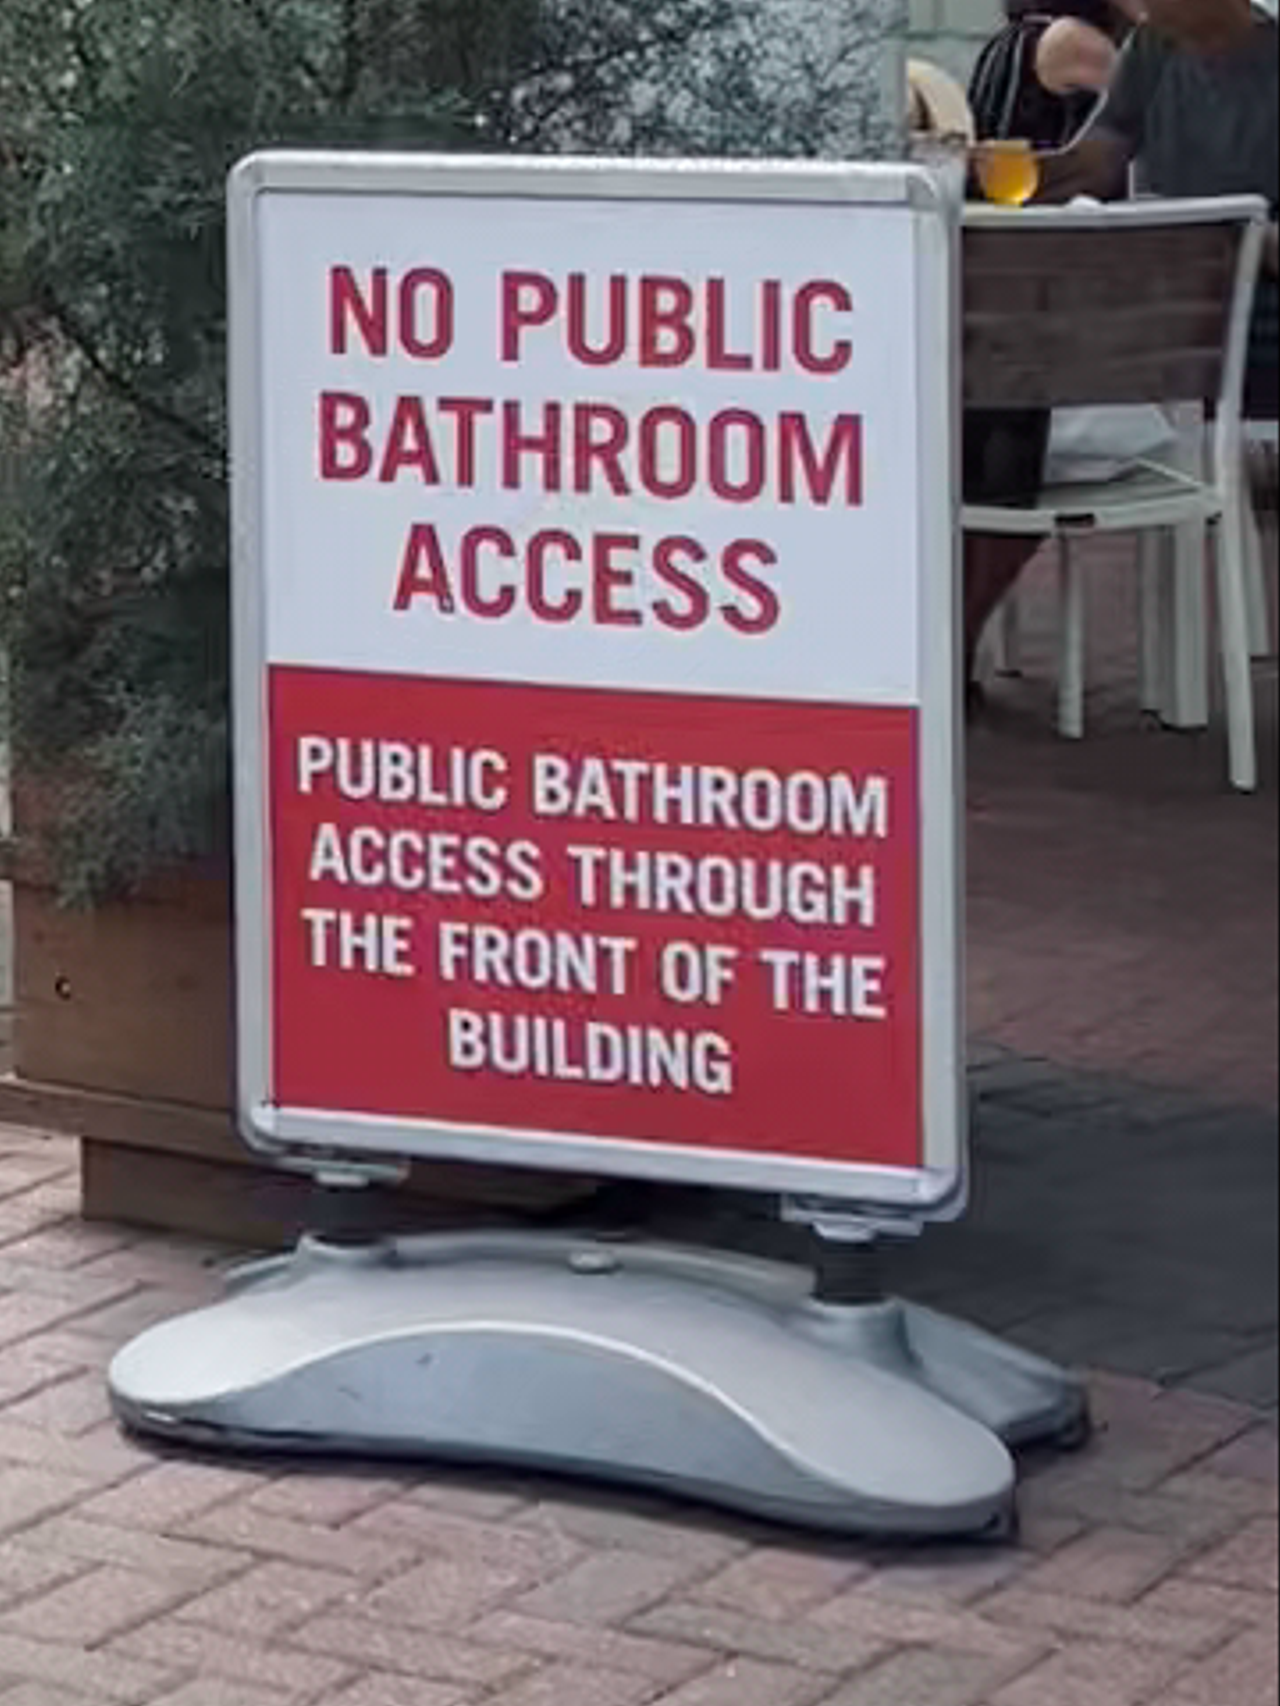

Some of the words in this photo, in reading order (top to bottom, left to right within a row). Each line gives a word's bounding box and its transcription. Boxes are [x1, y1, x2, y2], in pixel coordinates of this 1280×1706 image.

[330, 266, 453, 358] NO
[501, 270, 853, 374] PUBLIC
[319, 391, 863, 506] BATHROOM
[393, 523, 781, 634] ACCESS
[297, 735, 507, 810] PUBLIC
[533, 754, 887, 838] BATHROOM
[309, 822, 544, 900] ACCESS
[566, 844, 875, 927] THROUGH
[301, 907, 415, 977] THE
[439, 921, 638, 996] FRONT
[661, 940, 738, 1005] OF
[759, 949, 887, 1018] THE
[449, 1007, 732, 1093] BUILDING
